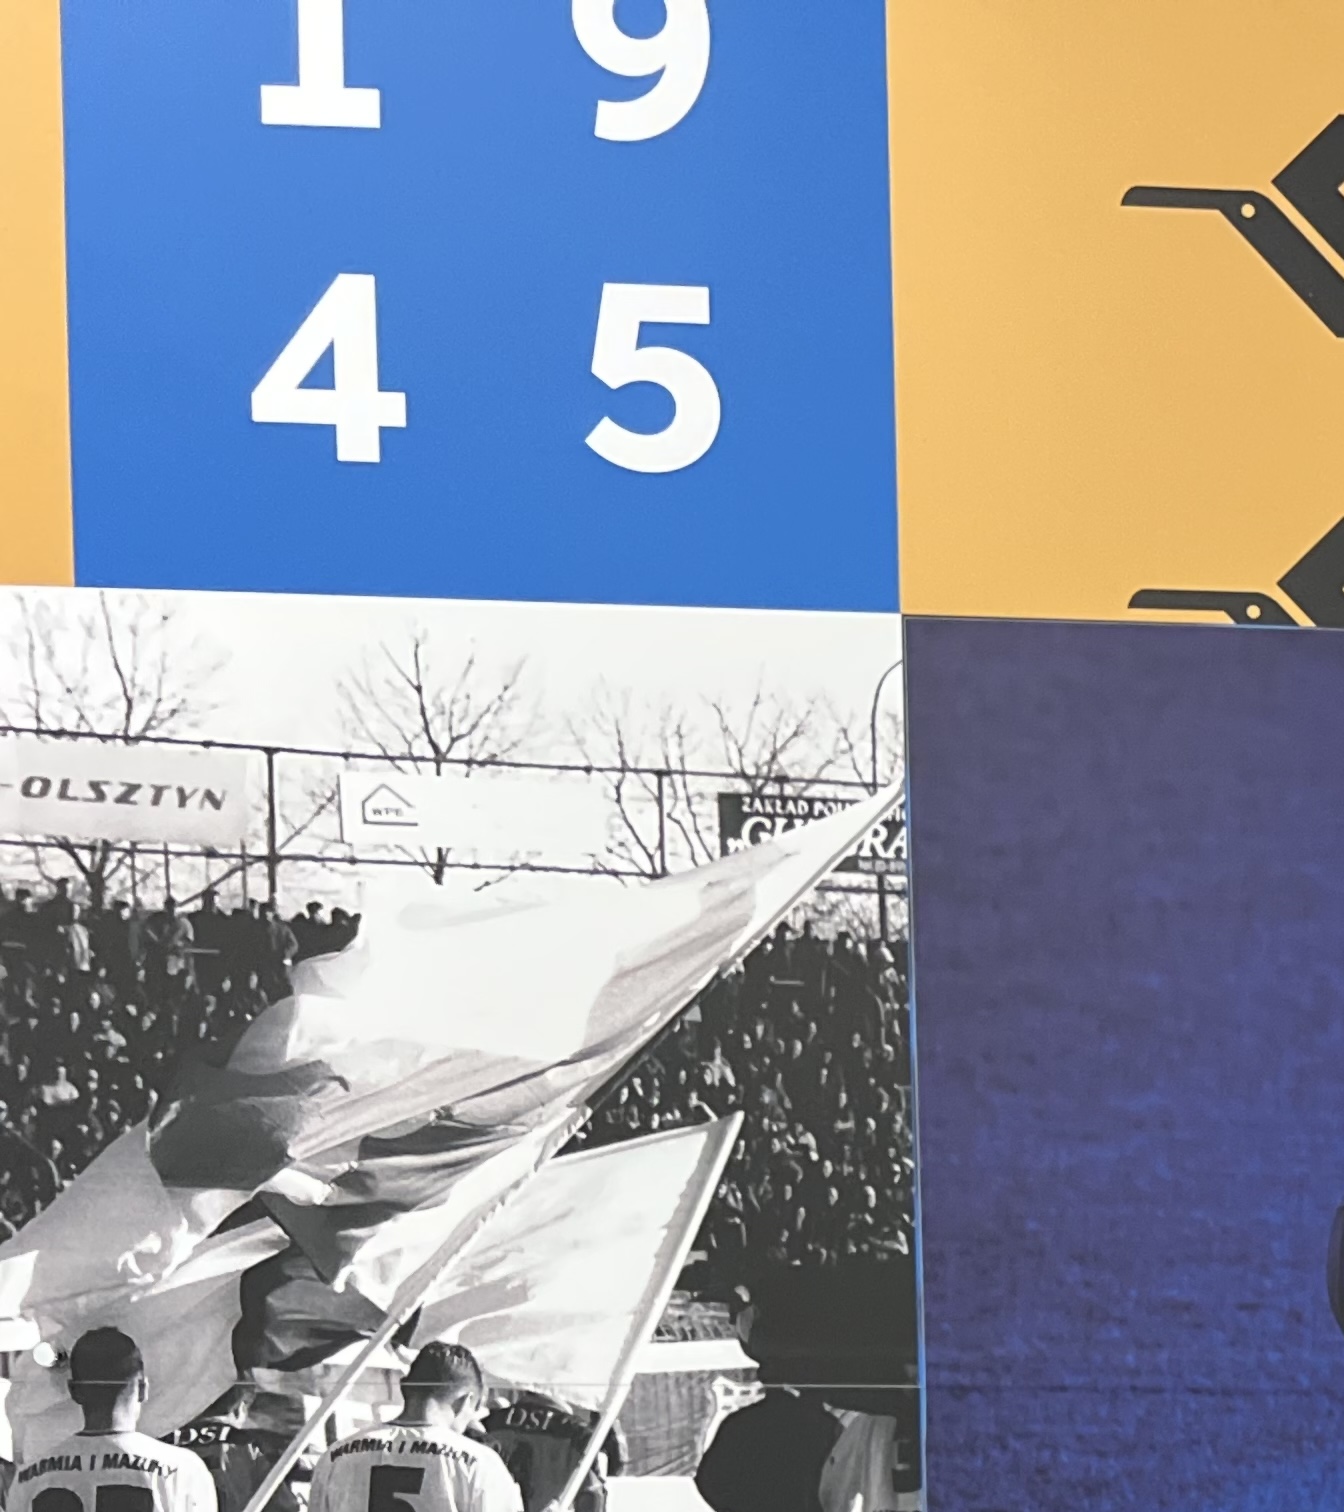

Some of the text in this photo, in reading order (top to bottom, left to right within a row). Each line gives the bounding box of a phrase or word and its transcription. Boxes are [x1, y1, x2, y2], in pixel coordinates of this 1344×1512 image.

[261, 0, 711, 142] 1 9
[251, 273, 721, 474] 4 5
